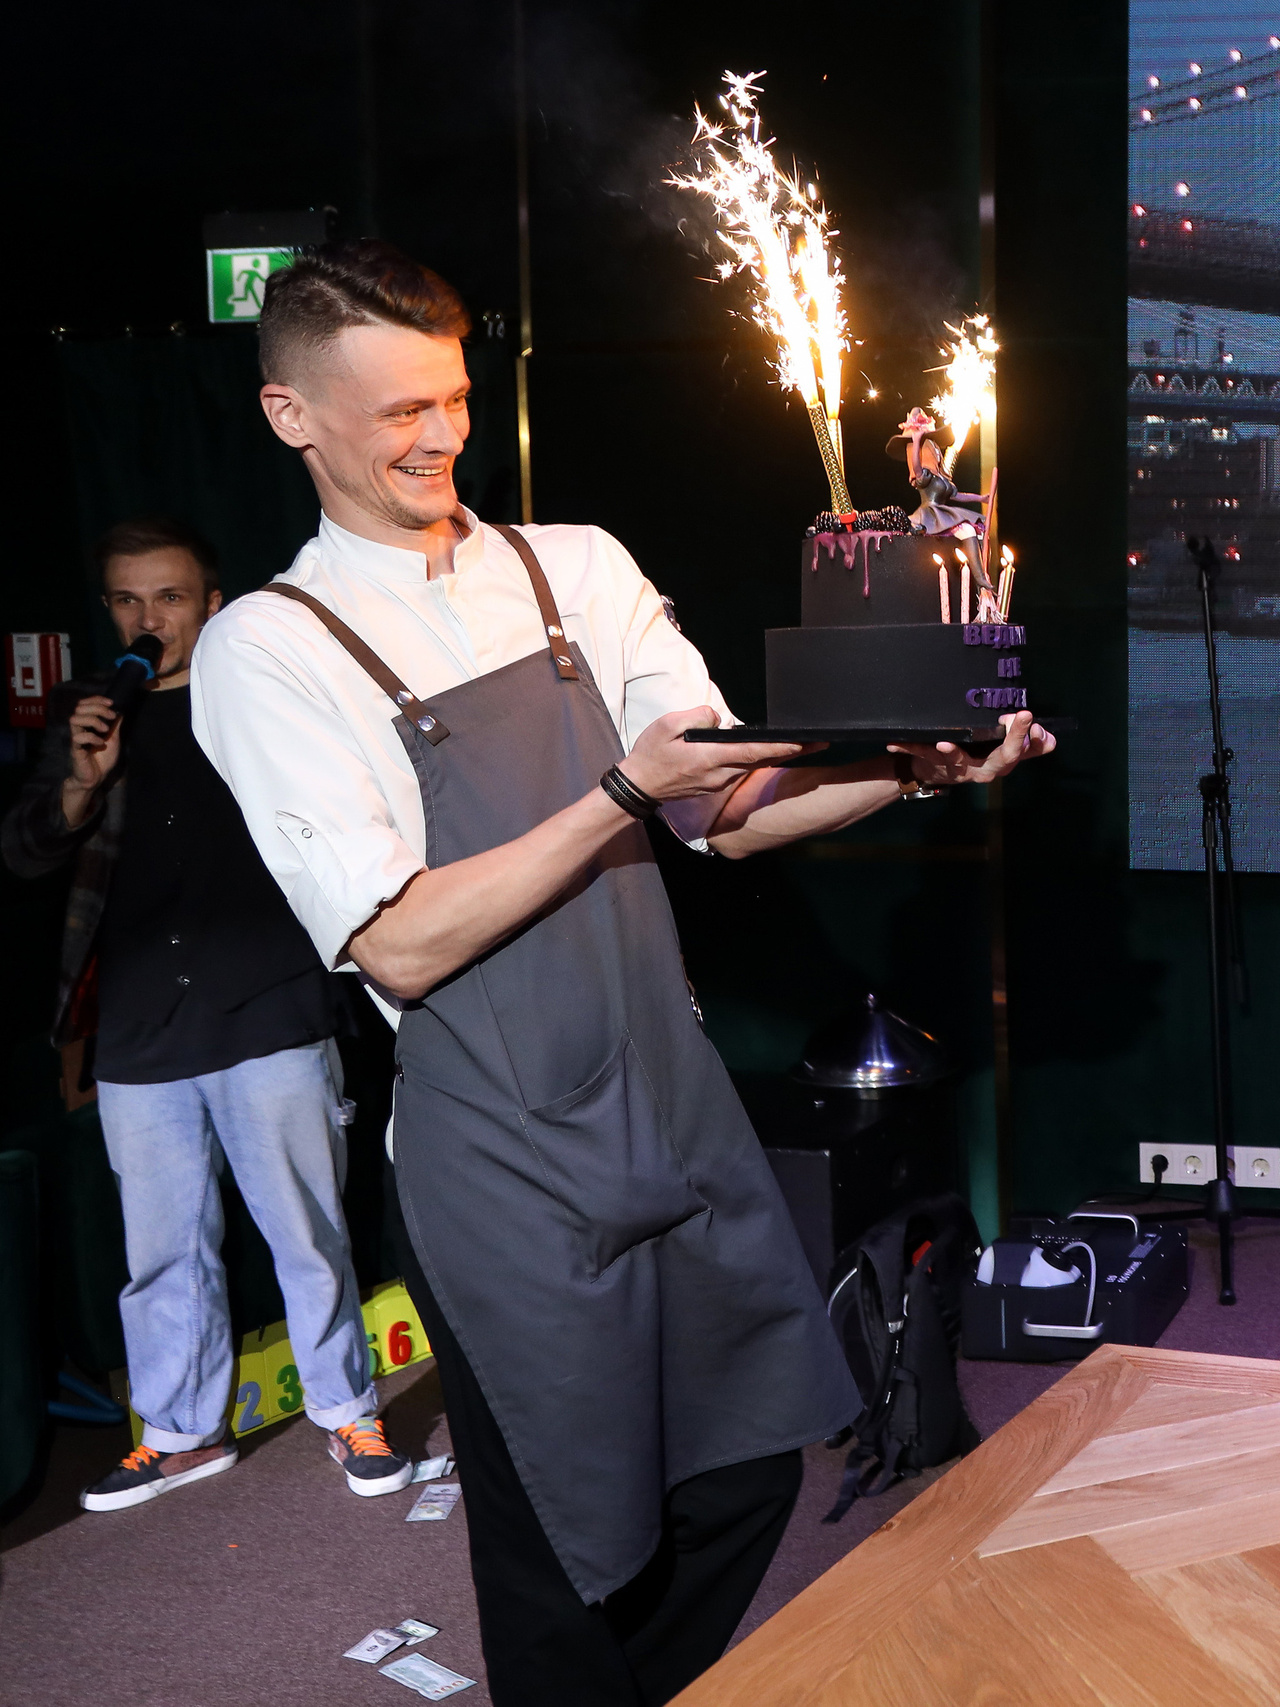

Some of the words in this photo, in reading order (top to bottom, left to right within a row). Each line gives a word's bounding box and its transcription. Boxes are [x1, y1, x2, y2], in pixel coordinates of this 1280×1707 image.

[18, 705, 44, 715] FIRE
[236, 1381, 264, 1432] 2
[277, 1364, 303, 1412] 3
[388, 1321, 412, 1366] 6
